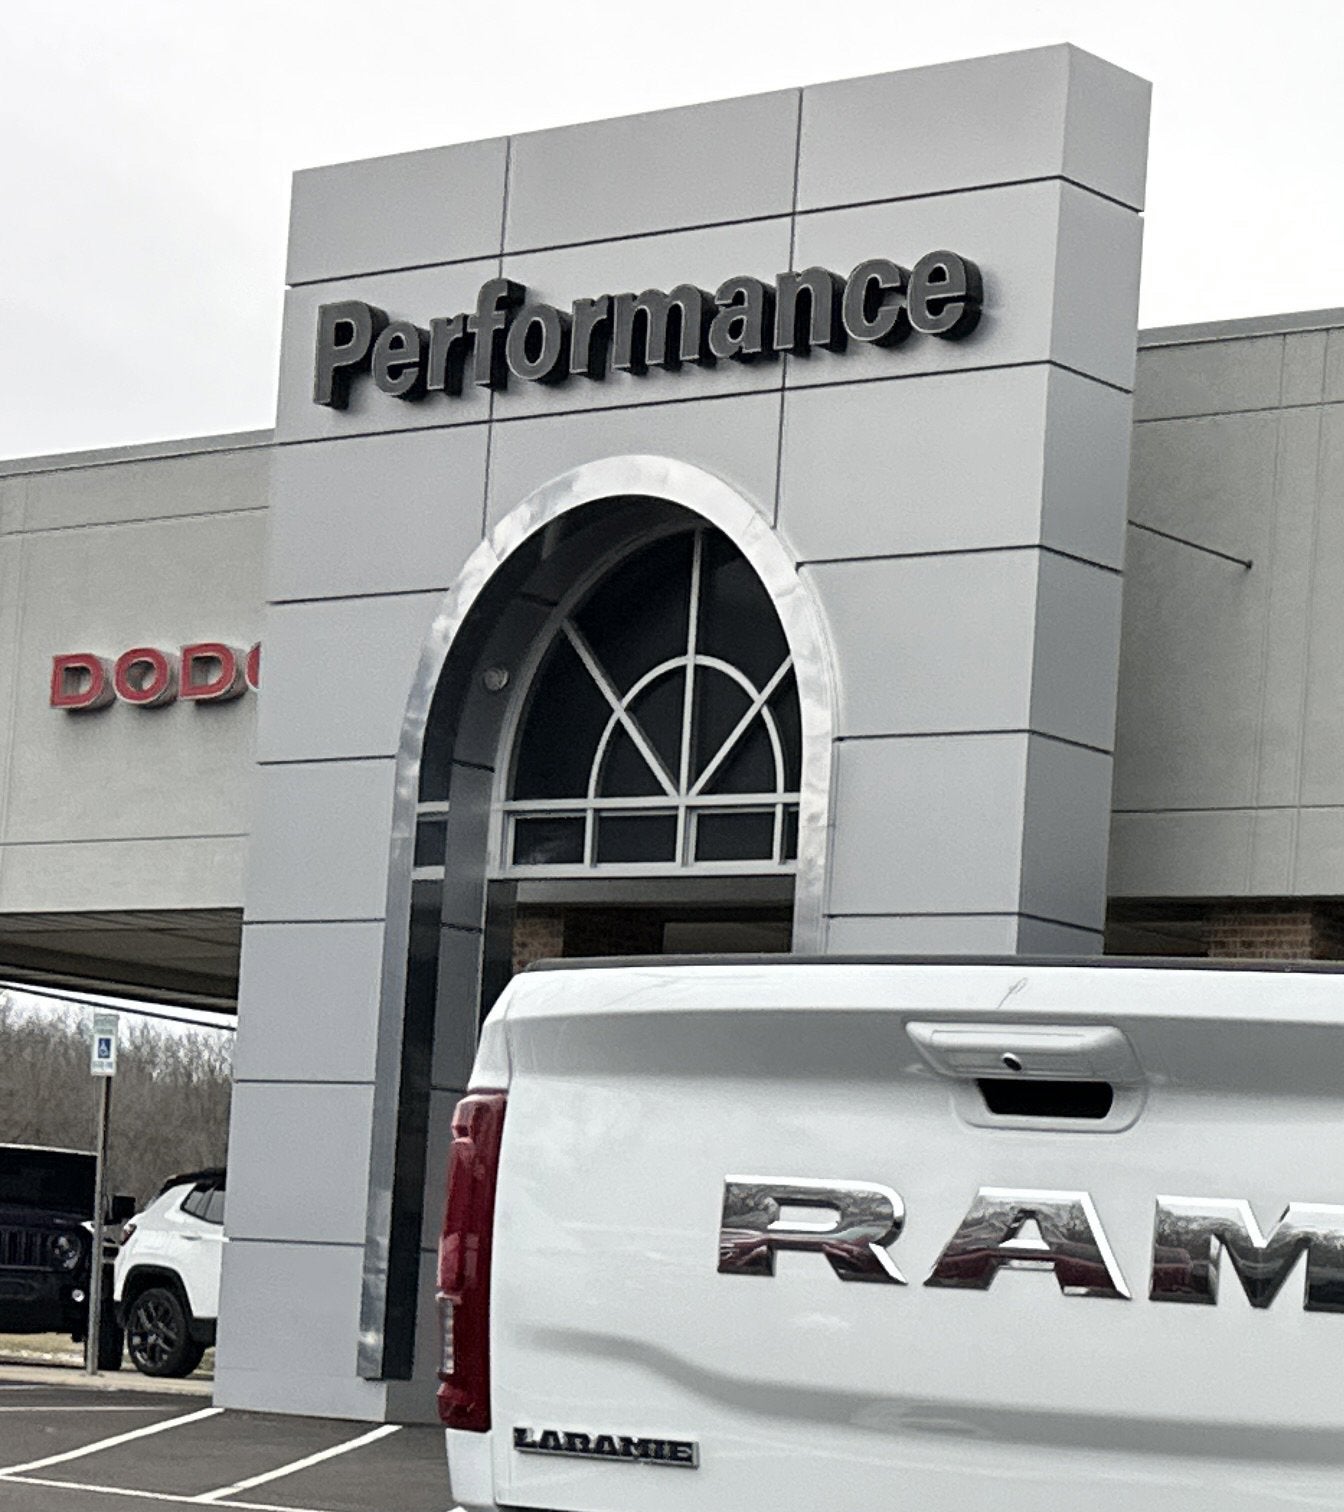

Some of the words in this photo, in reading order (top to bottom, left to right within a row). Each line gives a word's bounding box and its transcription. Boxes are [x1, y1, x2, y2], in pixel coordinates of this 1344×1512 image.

[313, 250, 983, 410] Performance
[50, 641, 261, 712] DOD
[512, 1426, 700, 1470] LARAMIE
